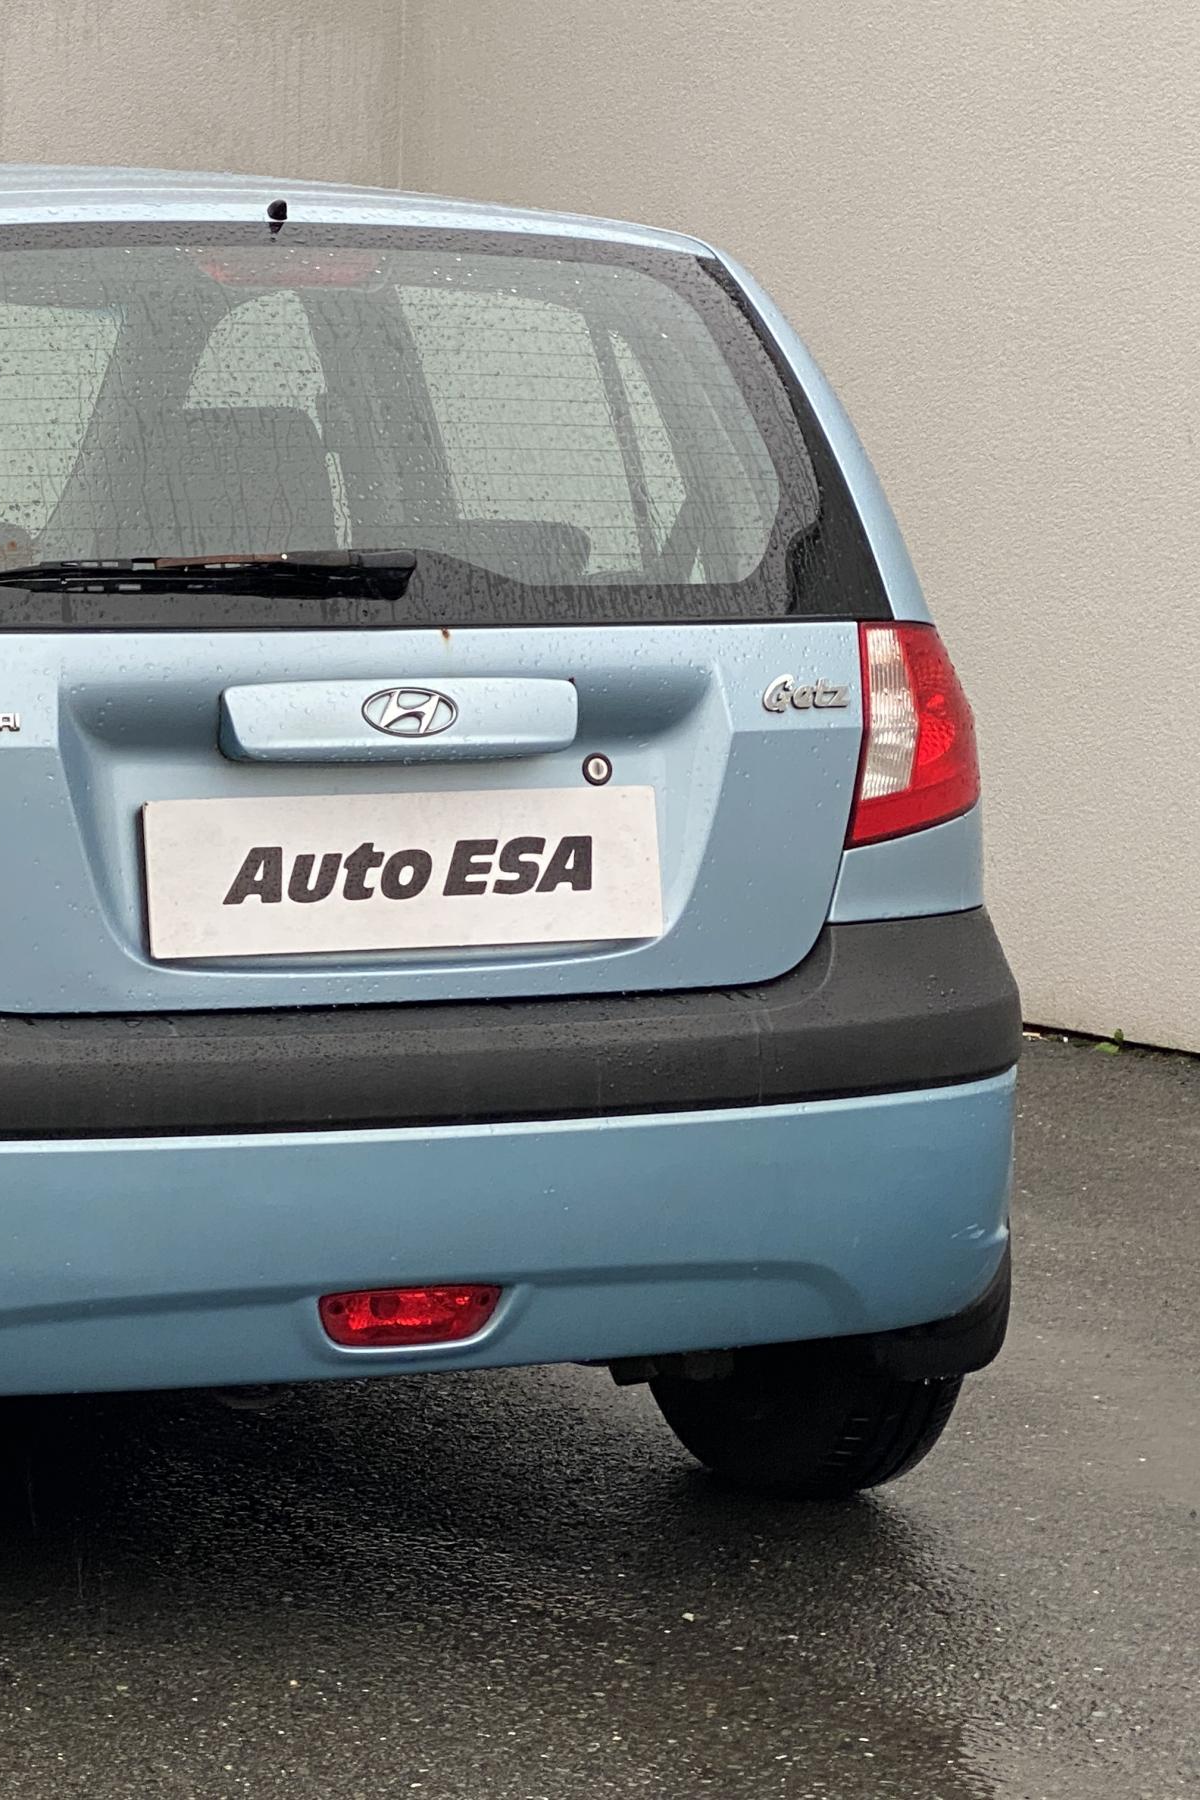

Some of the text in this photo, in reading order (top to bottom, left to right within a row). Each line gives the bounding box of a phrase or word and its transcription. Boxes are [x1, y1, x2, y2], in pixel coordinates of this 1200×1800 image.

[763, 673, 850, 713] Getz
[223, 835, 593, 906] Auto ESA
